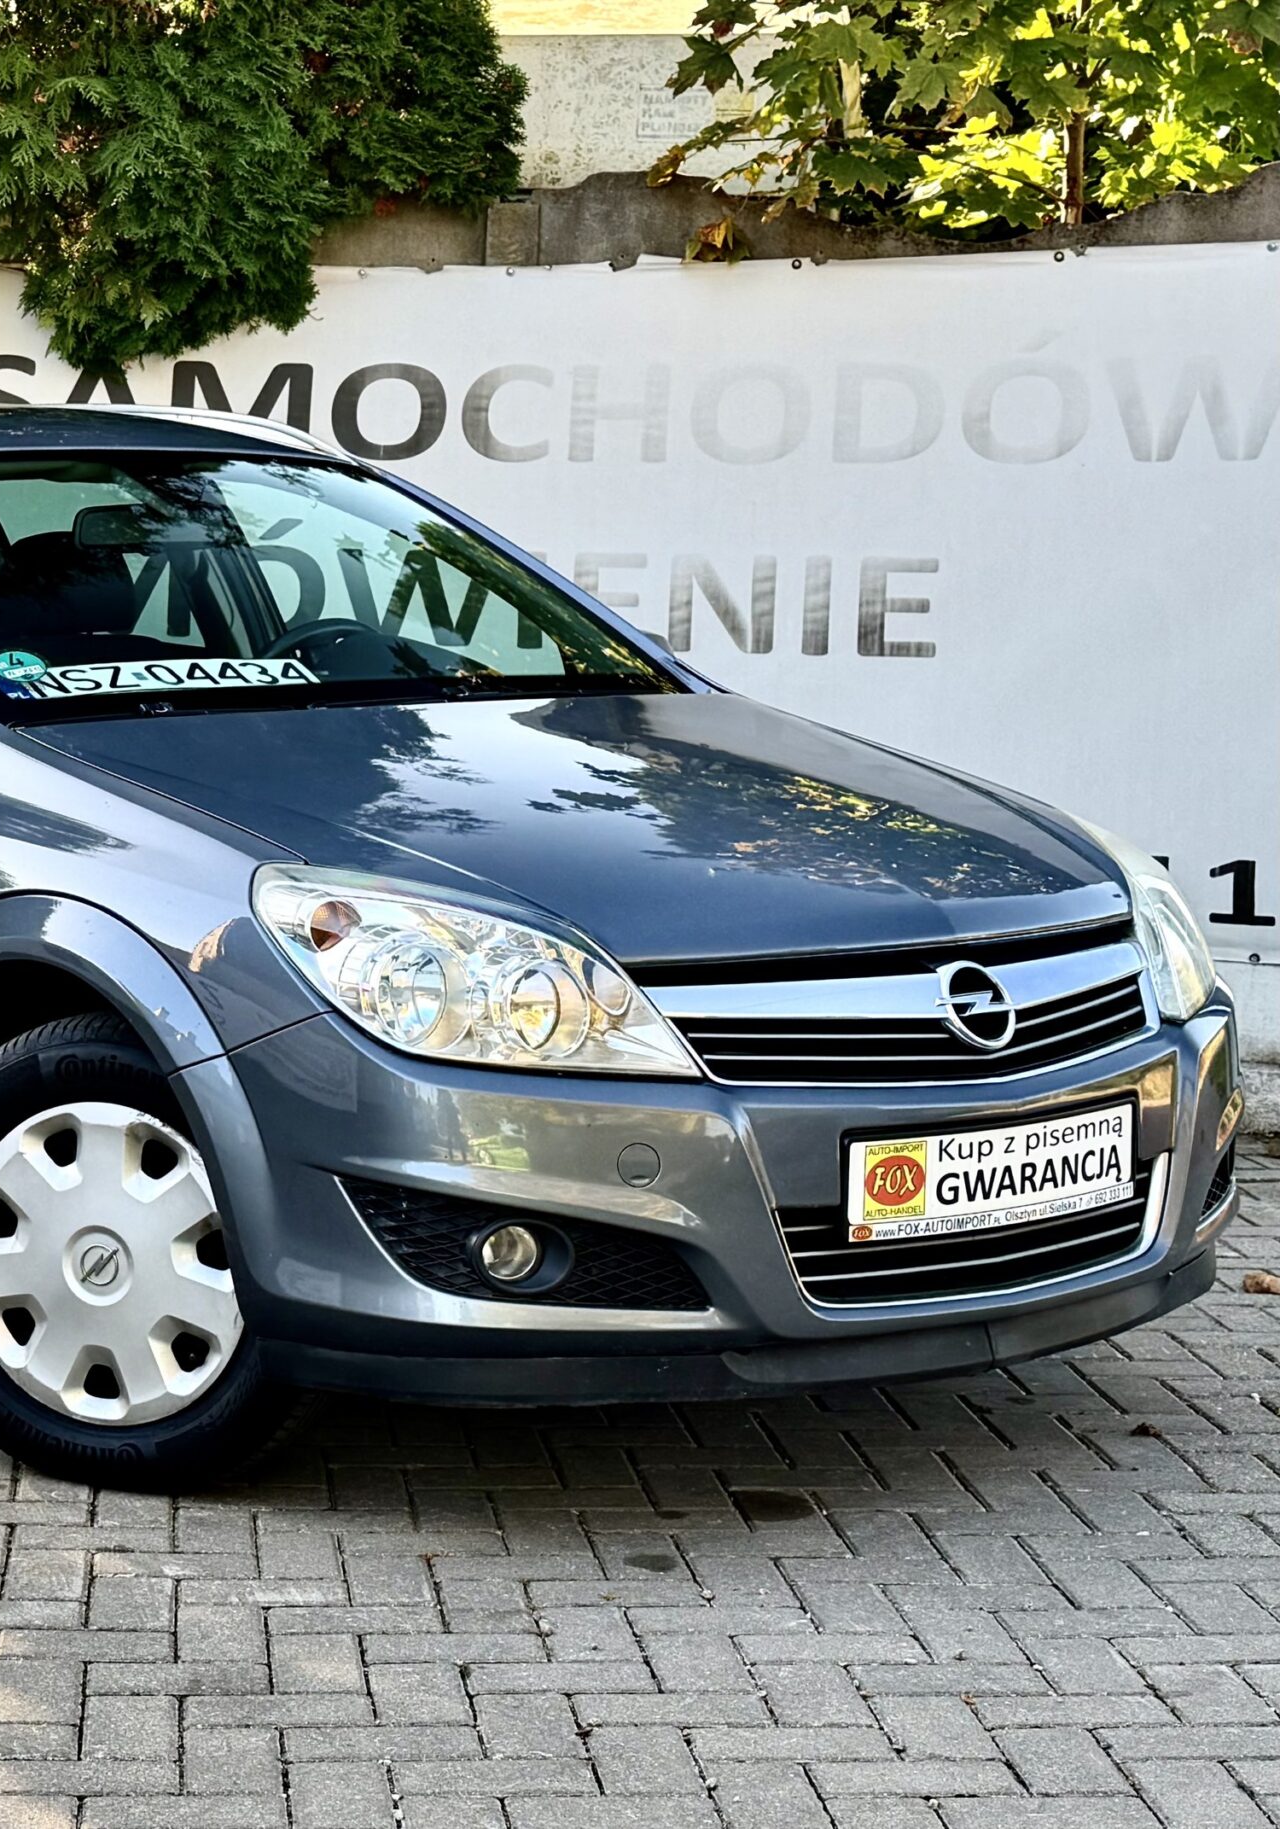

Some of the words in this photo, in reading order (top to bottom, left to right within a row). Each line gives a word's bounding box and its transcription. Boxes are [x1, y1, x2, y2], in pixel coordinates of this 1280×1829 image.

[27, 666, 141, 698] NSZ
[144, 662, 316, 686] 04434
[868, 1143, 924, 1156] AUTO-IMPORT
[938, 1137, 994, 1163] Kup
[1004, 1136, 1015, 1154] z
[1025, 1115, 1124, 1156] pisemną
[872, 1164, 919, 1198] FOX
[936, 1144, 1123, 1205] GWARANCJĄ
[865, 1205, 923, 1218] AUTO-HANDEL
[1005, 1208, 1038, 1222] Olsztyn
